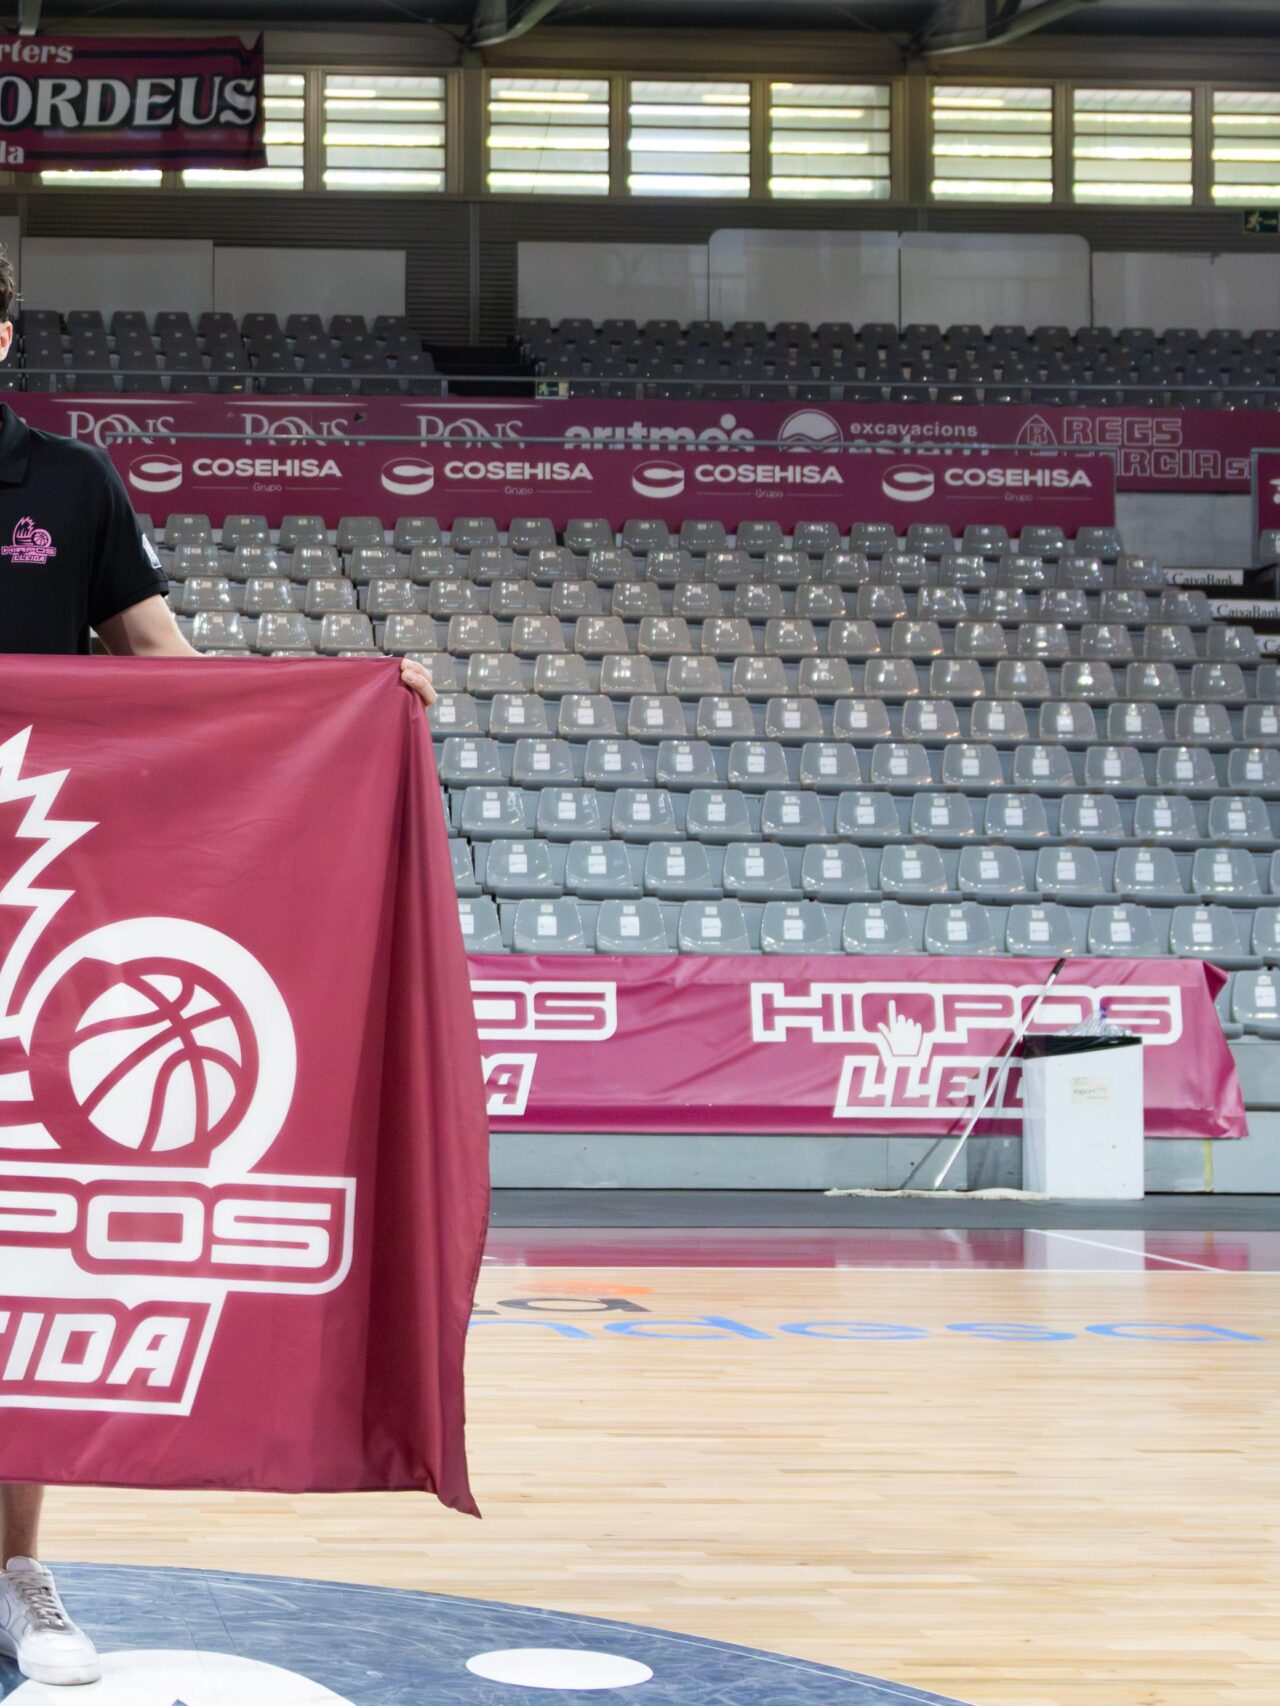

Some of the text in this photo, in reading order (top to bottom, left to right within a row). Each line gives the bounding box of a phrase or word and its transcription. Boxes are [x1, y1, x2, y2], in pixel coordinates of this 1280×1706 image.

[849, 421, 979, 437] excavacions
[192, 458, 343, 479] COSEHISA
[443, 461, 594, 481] COSEHISA
[694, 464, 844, 484] COSEHISA
[944, 468, 1093, 488] COSEHISA
[1172, 572, 1234, 585] CaixaBank
[468, 1315, 1267, 1343] ndesa
